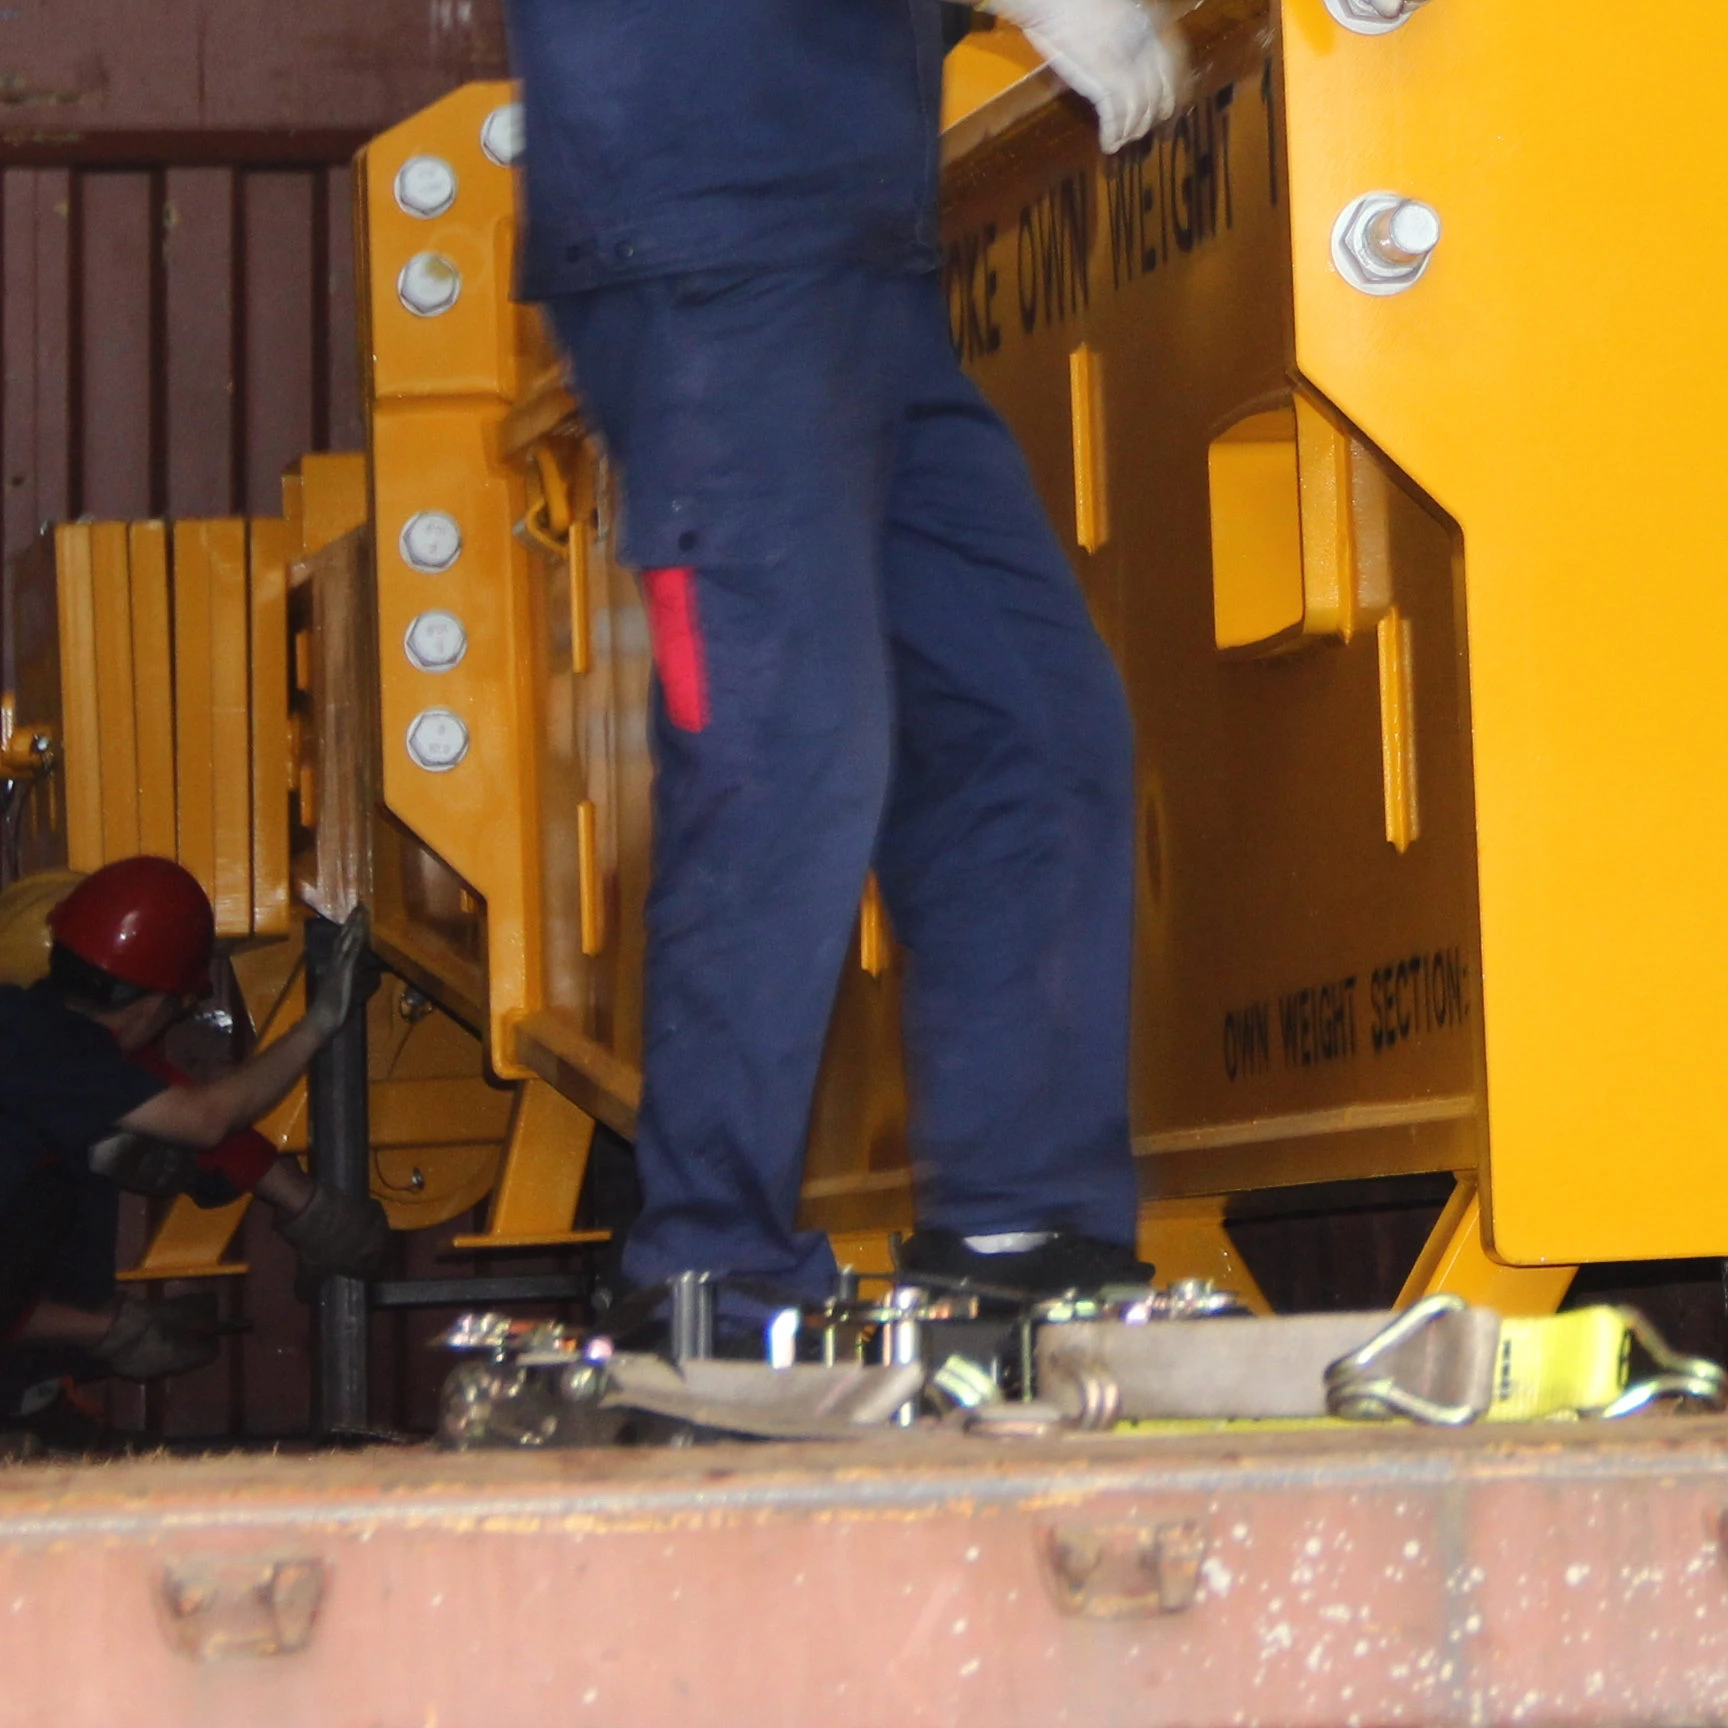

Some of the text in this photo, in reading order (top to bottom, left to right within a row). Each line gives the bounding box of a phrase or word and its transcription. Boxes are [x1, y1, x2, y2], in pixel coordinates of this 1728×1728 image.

[1017, 169, 1090, 335] OWN
[1103, 83, 1235, 291] WEIGHT
[1223, 998, 1270, 1083] OWN
[1278, 975, 1357, 1069] WEIGHT
